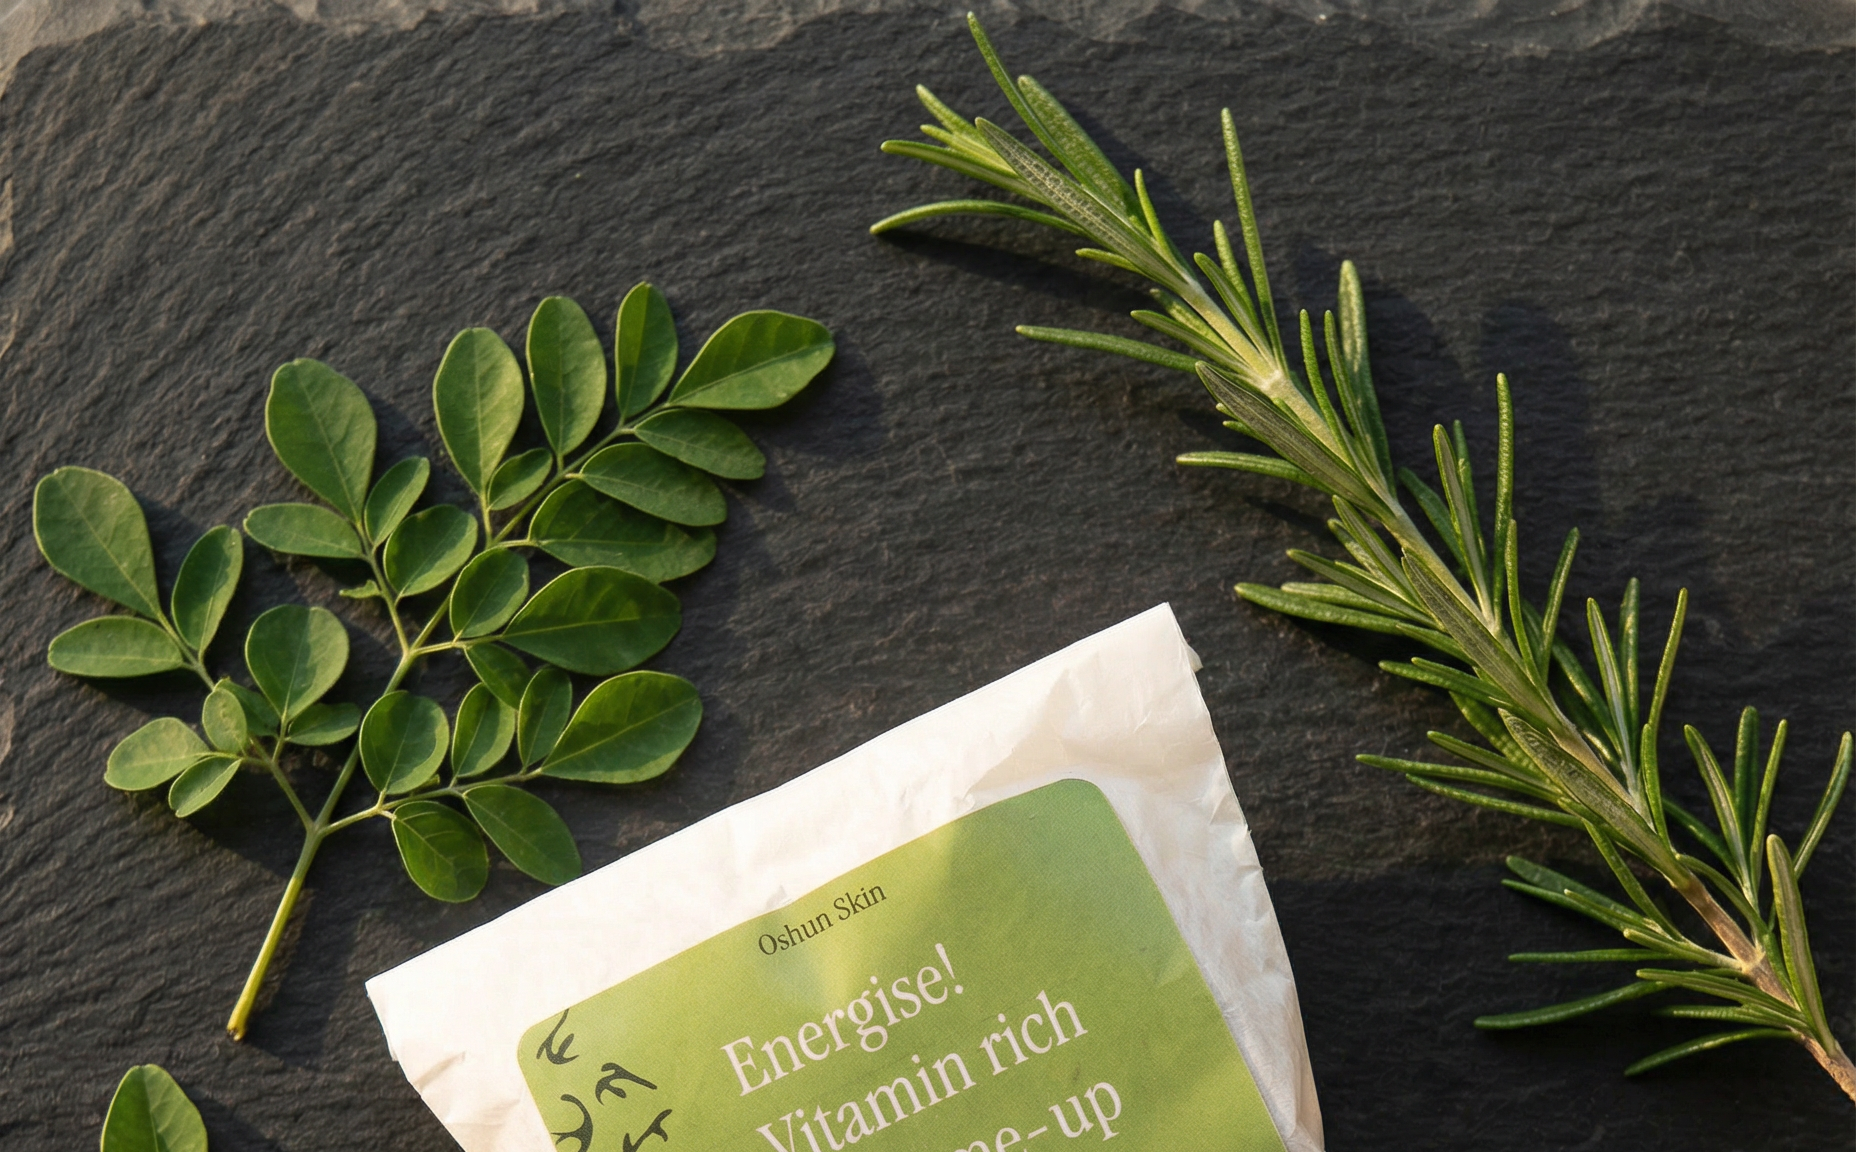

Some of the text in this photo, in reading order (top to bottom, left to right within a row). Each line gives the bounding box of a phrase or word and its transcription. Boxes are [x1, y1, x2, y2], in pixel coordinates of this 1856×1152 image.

[758, 882, 887, 957] Oshun Skin
[719, 943, 964, 1097] Energise!
[979, 989, 1089, 1076] rich
